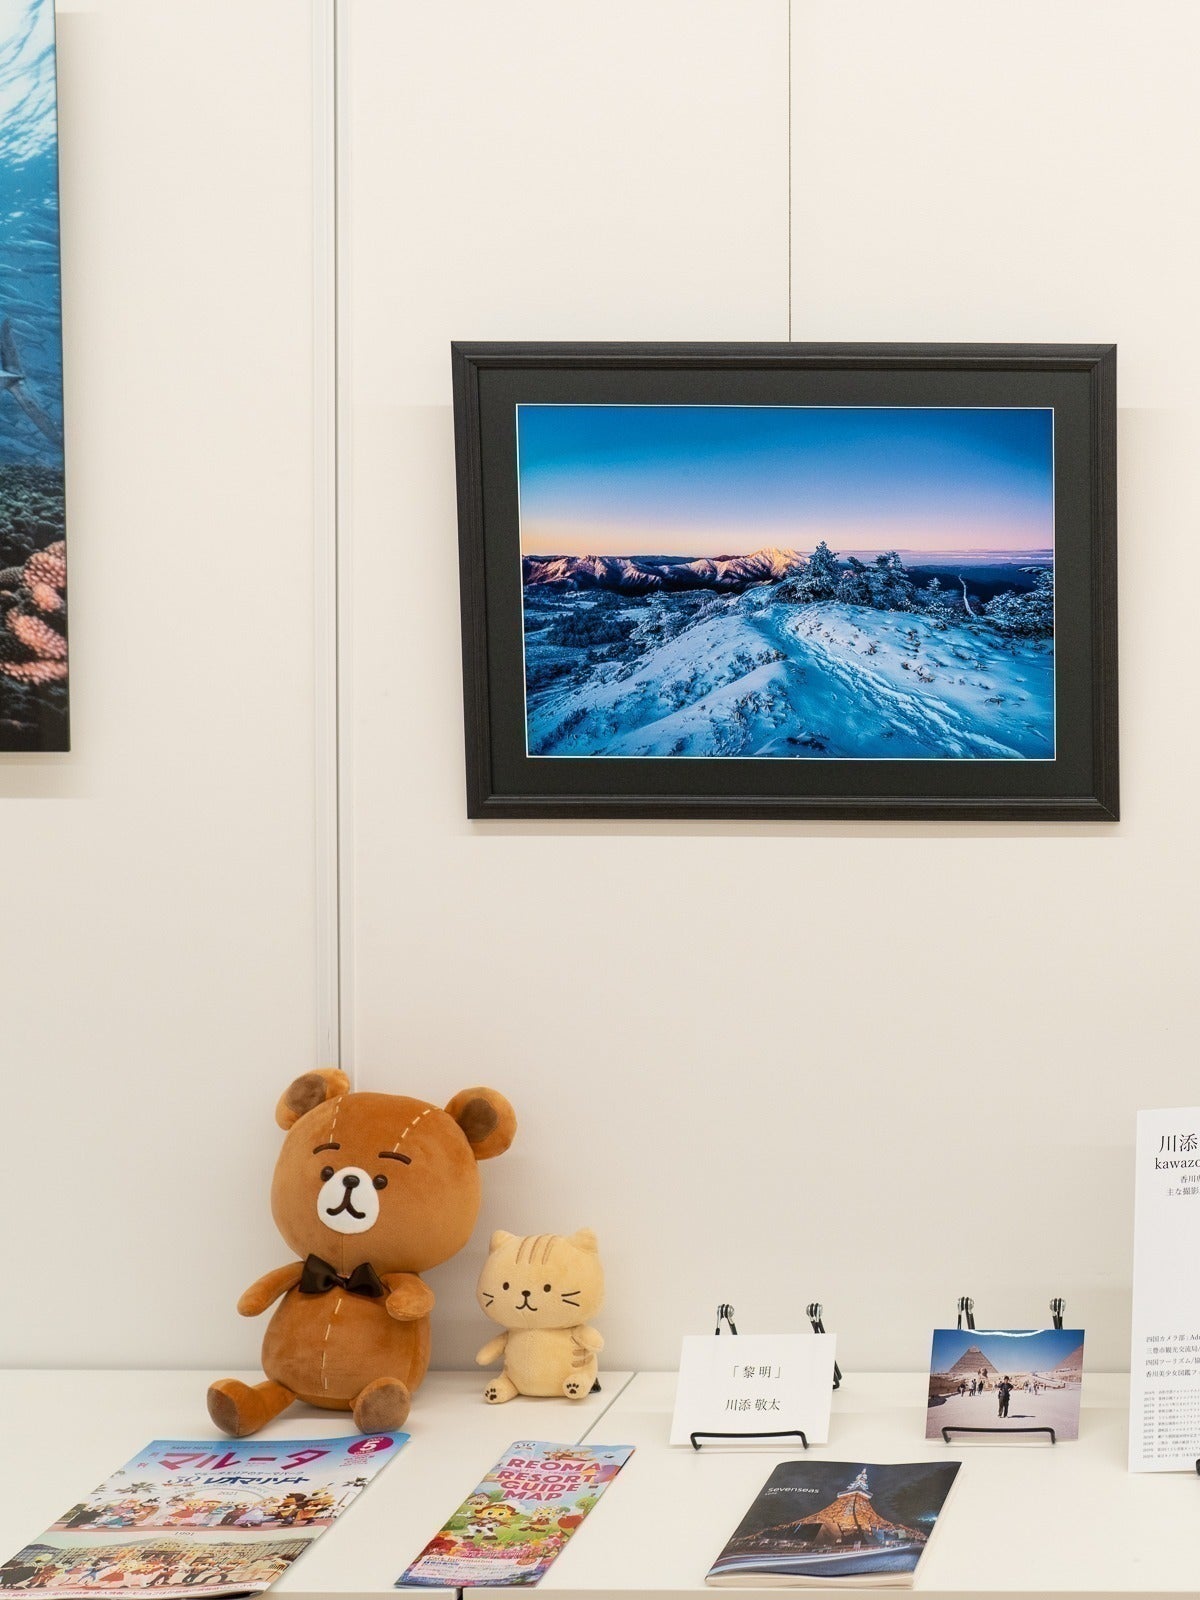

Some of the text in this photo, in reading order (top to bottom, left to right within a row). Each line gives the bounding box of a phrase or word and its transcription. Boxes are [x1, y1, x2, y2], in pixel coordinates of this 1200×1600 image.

[1158, 1133, 1198, 1153] 川添
[725, 1397, 781, 1412] 川添 敬太
[359, 1439, 381, 1452] 5
[157, 1448, 332, 1471] マルータ
[505, 1457, 603, 1473] REOMA
[495, 1470, 598, 1484] RESORT
[500, 1480, 582, 1493] GUIDE
[502, 1491, 564, 1502] MAP
